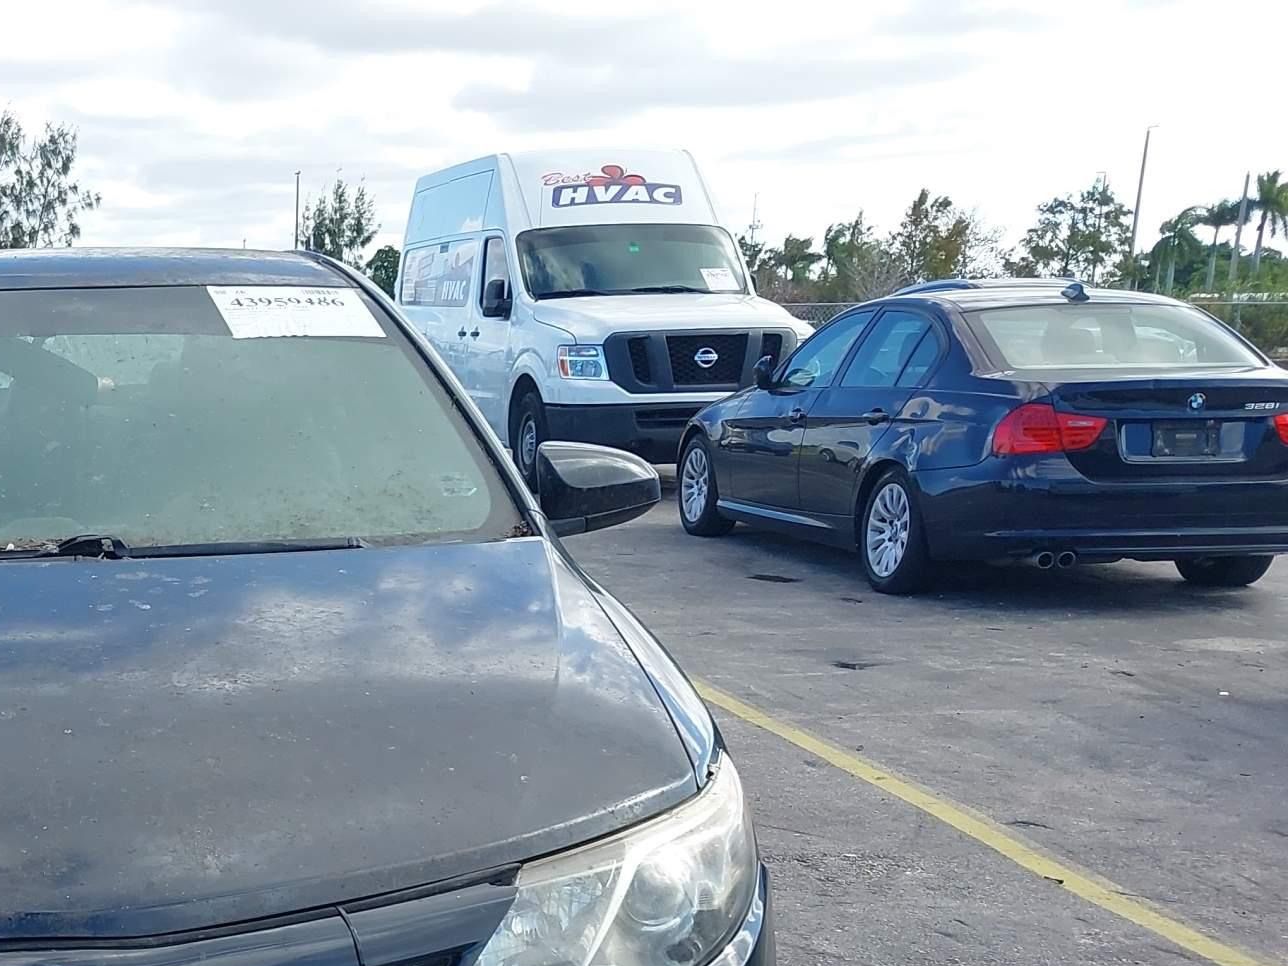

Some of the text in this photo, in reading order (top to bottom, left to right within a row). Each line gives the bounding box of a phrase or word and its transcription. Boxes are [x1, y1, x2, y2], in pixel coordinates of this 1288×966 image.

[542, 172, 593, 186] Best
[559, 186, 677, 206] HVAC
[441, 280, 466, 300] HVAC
[230, 297, 345, 307] 43959486
